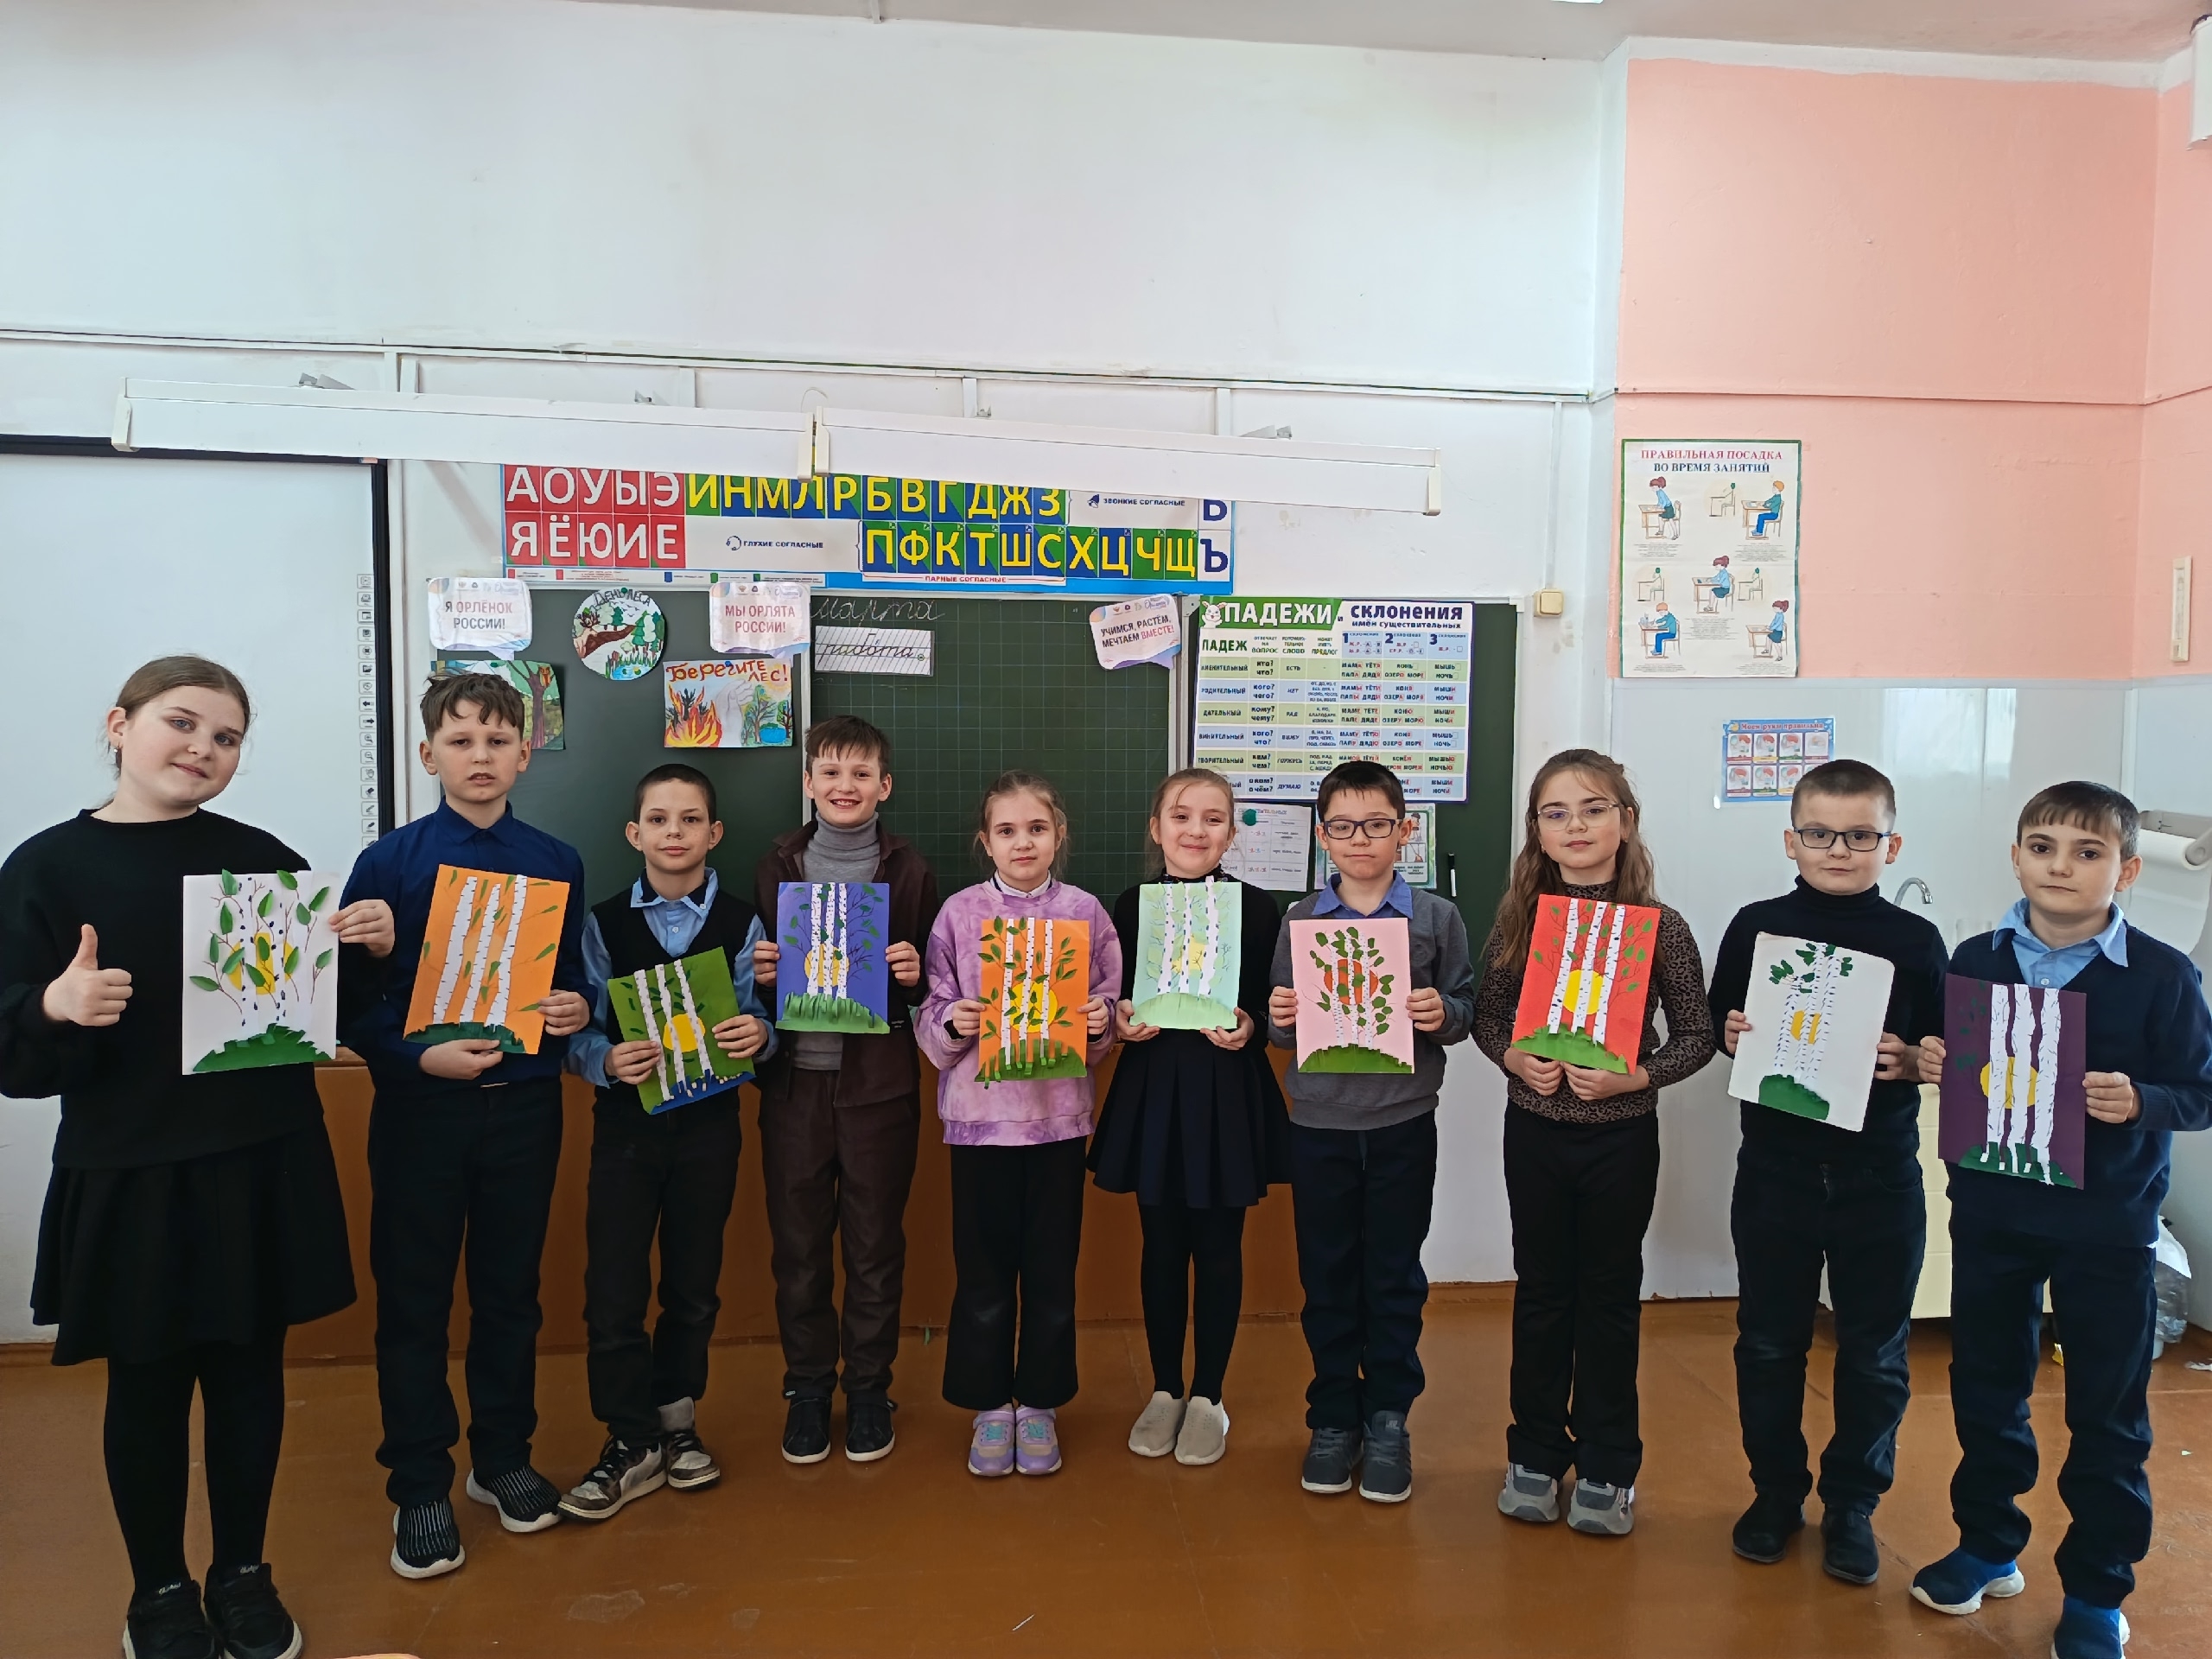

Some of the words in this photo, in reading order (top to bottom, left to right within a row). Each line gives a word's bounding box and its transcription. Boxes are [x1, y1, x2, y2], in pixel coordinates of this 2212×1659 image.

[1641, 449, 1724, 460] ПРАВИЛЬНАЯ
[1727, 450, 1783, 461] ПОСАДКА
[1654, 462, 1669, 472] ВО
[1671, 463, 1711, 472] ВРЕМЯ
[1713, 462, 1770, 473] ЗАНЯТИЙ
[445, 601, 453, 613] Я
[456, 600, 513, 614] ОРЛЁНОК
[725, 605, 746, 617] МЫ
[748, 605, 795, 618] ОРЛЯТА
[1224, 602, 1332, 626] ПАДЕЖИ
[453, 617, 505, 630] РОССИИ!
[734, 621, 786, 633] РОССИИ!
[1351, 619, 1377, 627] имён
[1379, 620, 1461, 629] существительных
[1102, 632, 1140, 648] МЕЧТАЕМ
[1141, 625, 1175, 640] ВМЕСТЕ!
[1342, 632, 1349, 644] 1
[1384, 632, 1394, 644] 2
[1429, 633, 1438, 645] 3
[1202, 639, 1248, 654] ПАДЕЖ
